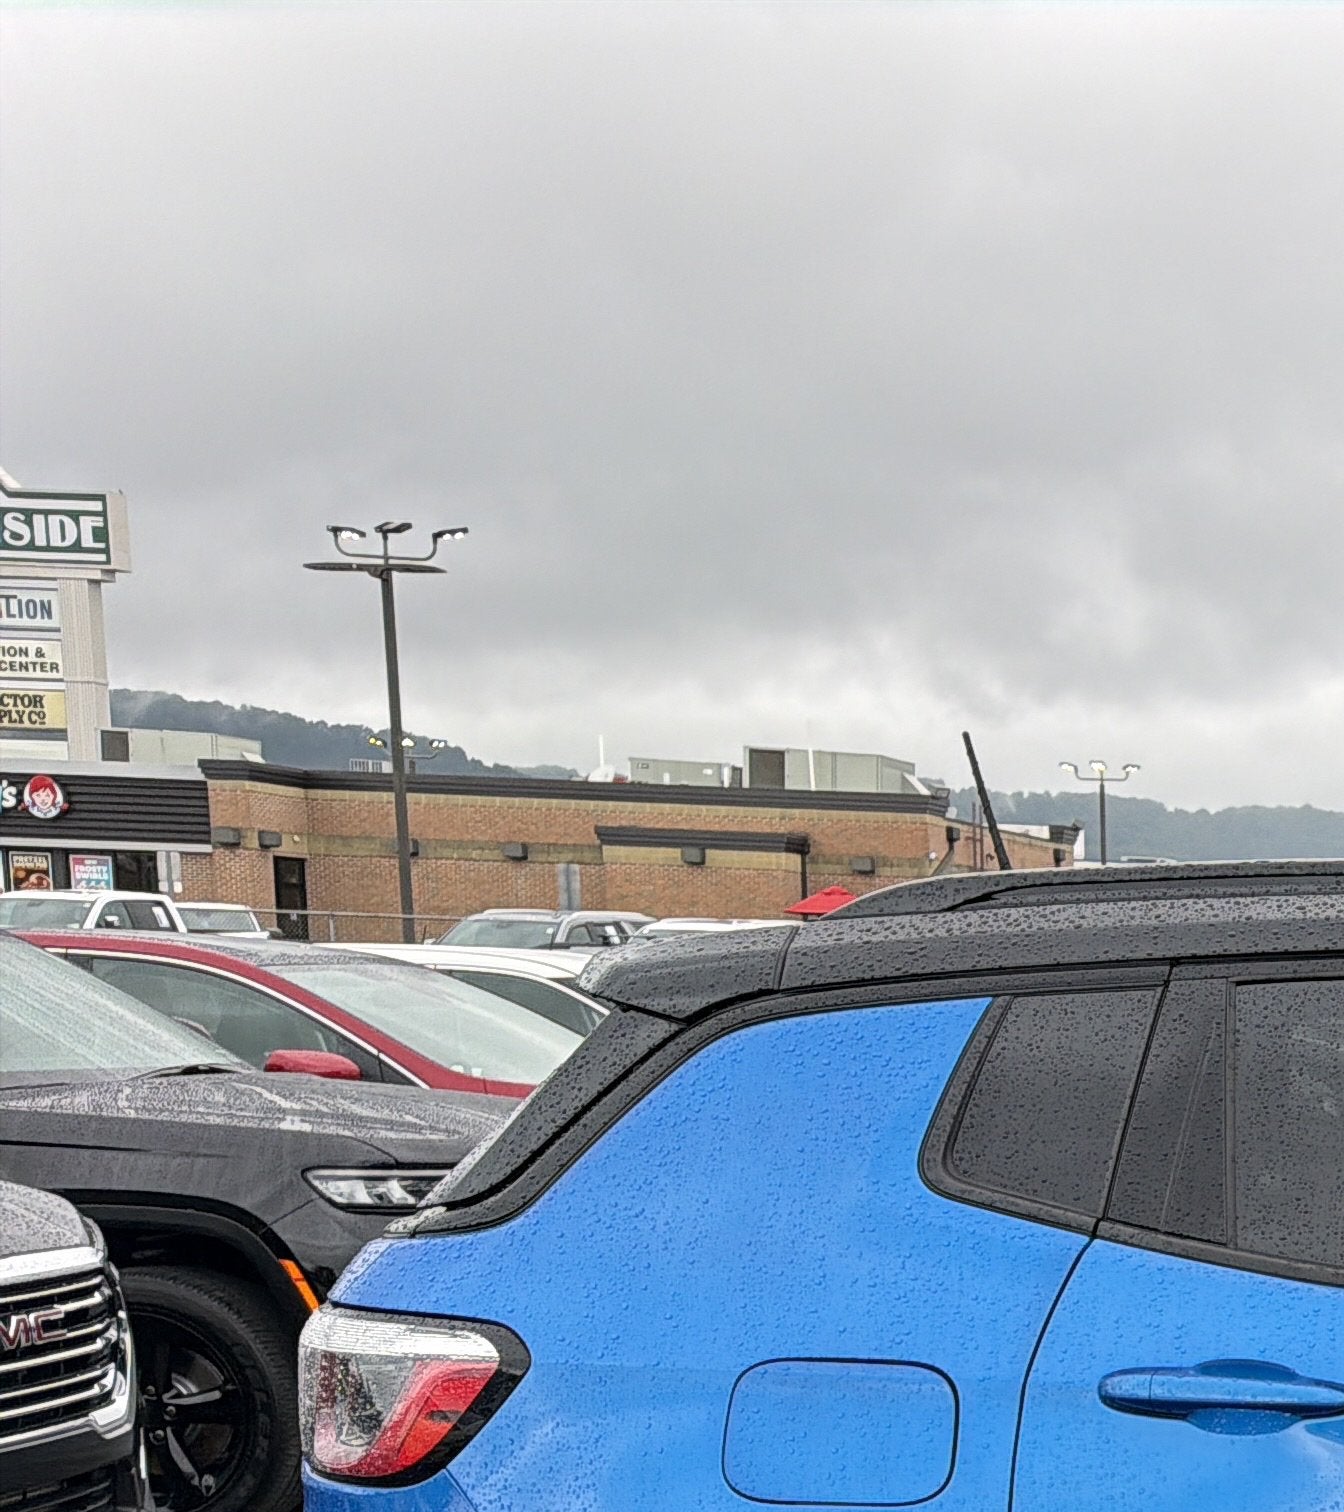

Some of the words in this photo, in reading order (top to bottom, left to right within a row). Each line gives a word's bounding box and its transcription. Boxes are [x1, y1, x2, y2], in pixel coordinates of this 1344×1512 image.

[3, 512, 106, 549] SIDE
[6, 597, 53, 620] LION
[0, 646, 29, 658] ION
[34, 646, 46, 659] &
[0, 779, 17, 808] 's
